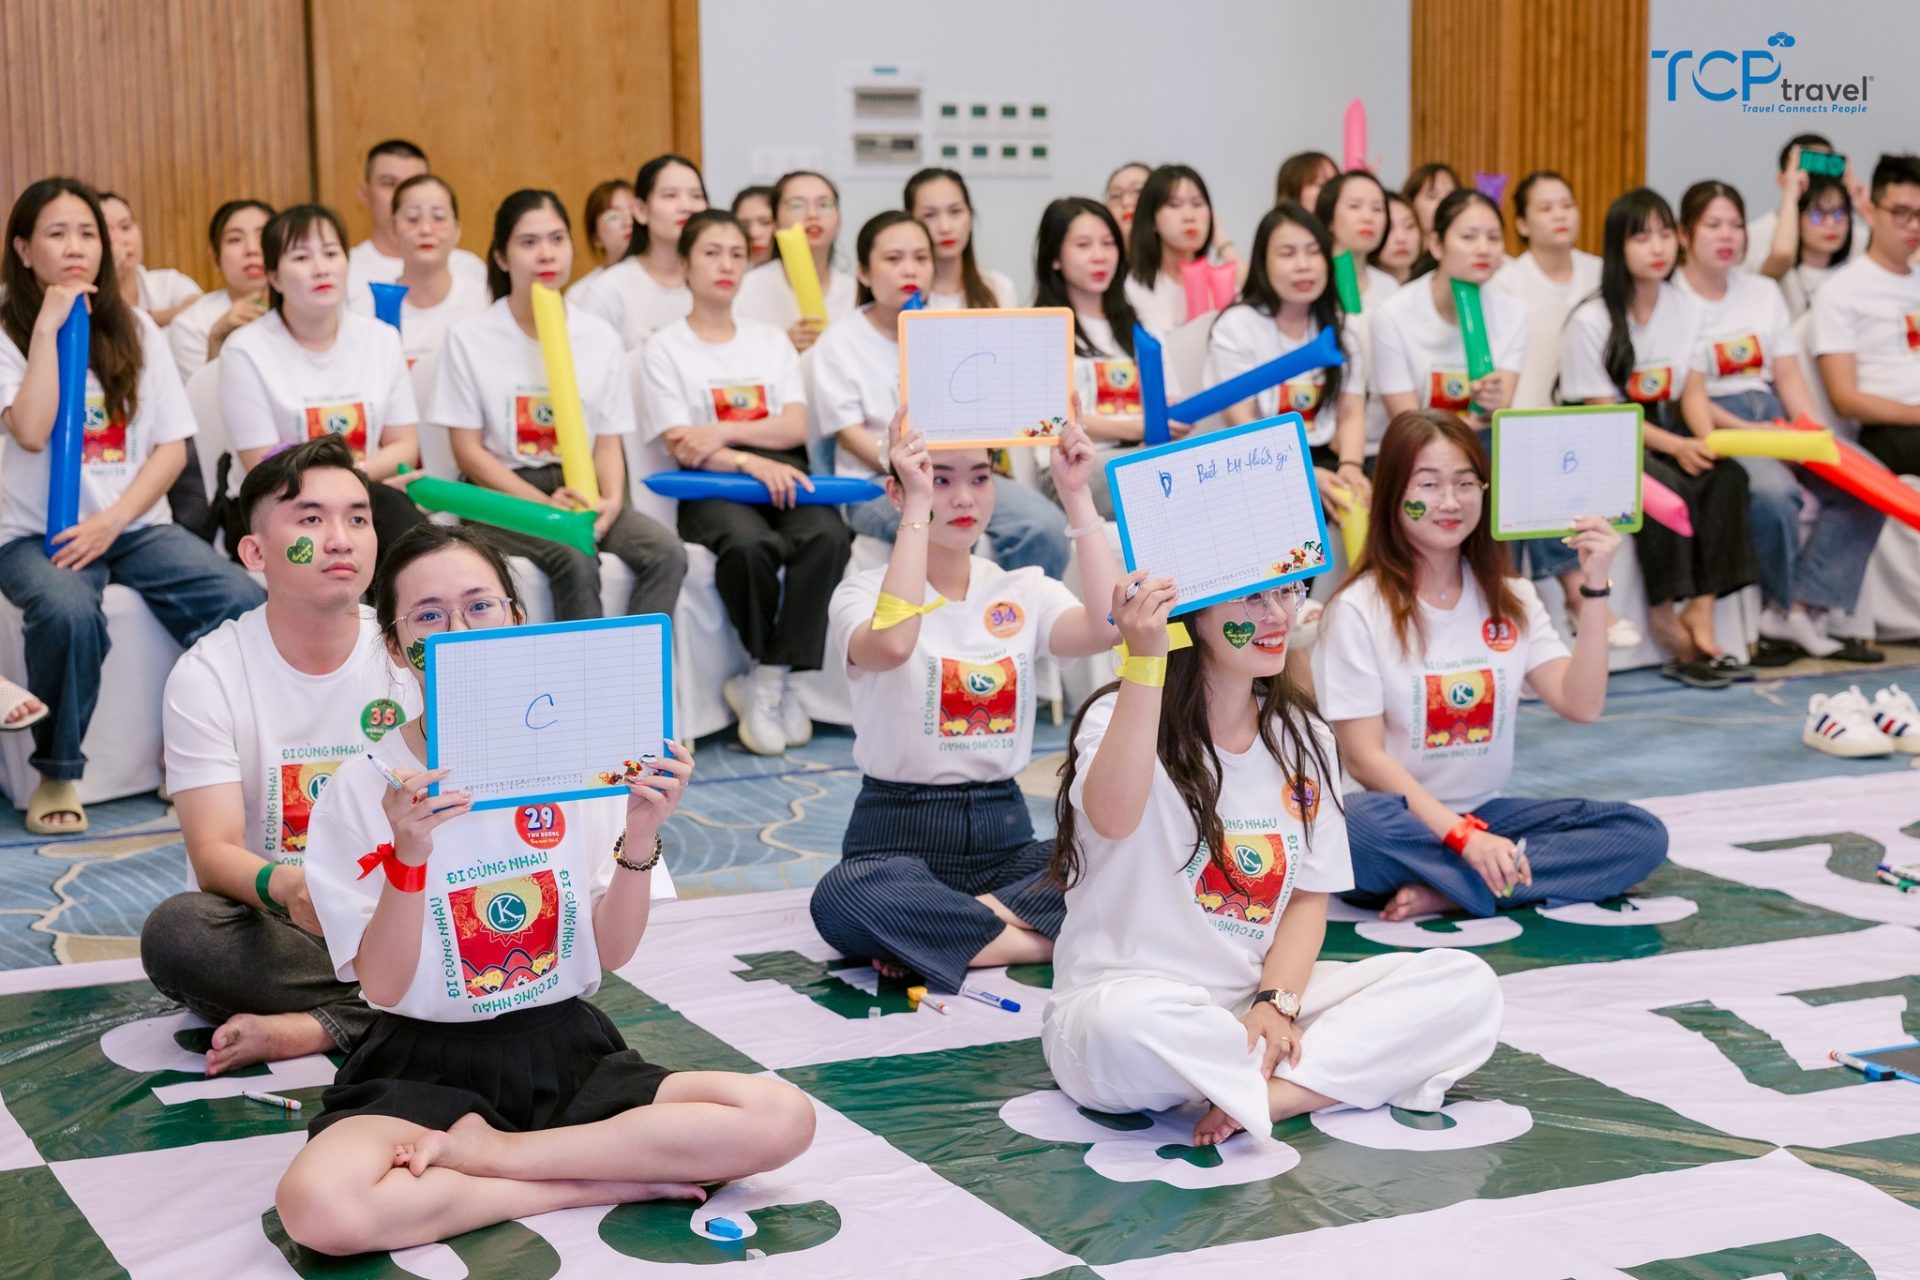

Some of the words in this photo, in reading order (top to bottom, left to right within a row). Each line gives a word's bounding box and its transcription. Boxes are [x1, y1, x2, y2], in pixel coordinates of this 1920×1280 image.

[949, 351, 997, 404] C
[1562, 450, 1579, 475] B
[370, 707, 397, 727] 35
[524, 693, 559, 731] C
[524, 806, 555, 831] 29
[1245, 817, 1278, 830] NHAU
[446, 869, 466, 885] ĐI
[468, 859, 507, 879] CÙNG
[509, 851, 549, 871] NHAU
[559, 868, 572, 888] ĐI
[429, 897, 450, 936] NHAU
[561, 927, 576, 959] NHAU
[441, 938, 457, 978] CÙNG
[444, 980, 460, 999] ĐI
[472, 996, 513, 1014] NHAU
